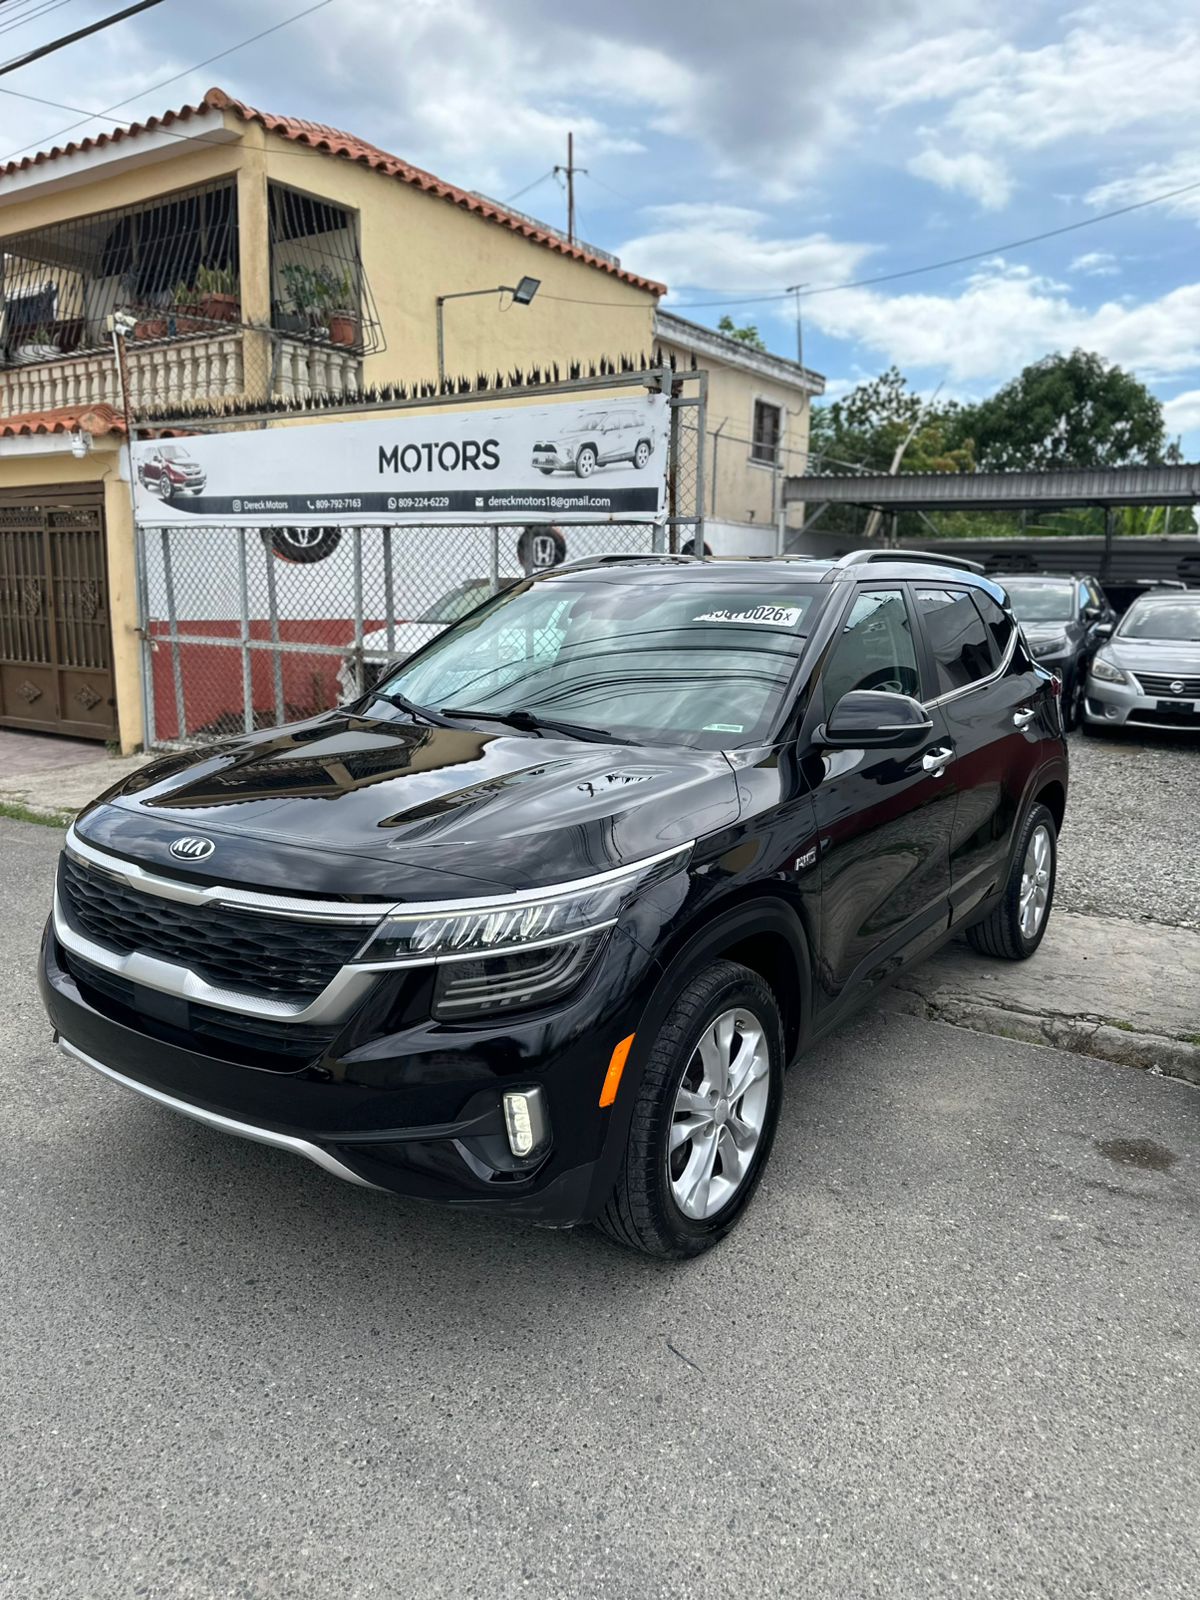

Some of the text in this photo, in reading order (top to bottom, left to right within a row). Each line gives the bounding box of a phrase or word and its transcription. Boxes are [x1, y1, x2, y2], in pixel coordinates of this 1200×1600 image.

[379, 439, 500, 473] MOTORS
[244, 500, 288, 510] Dereck Motors
[315, 498, 361, 509] 809-792-7163
[398, 497, 449, 508] 809-224-6229
[488, 495, 611, 509] dereckmotors18@gmail.com
[173, 837, 207, 856] KIA
